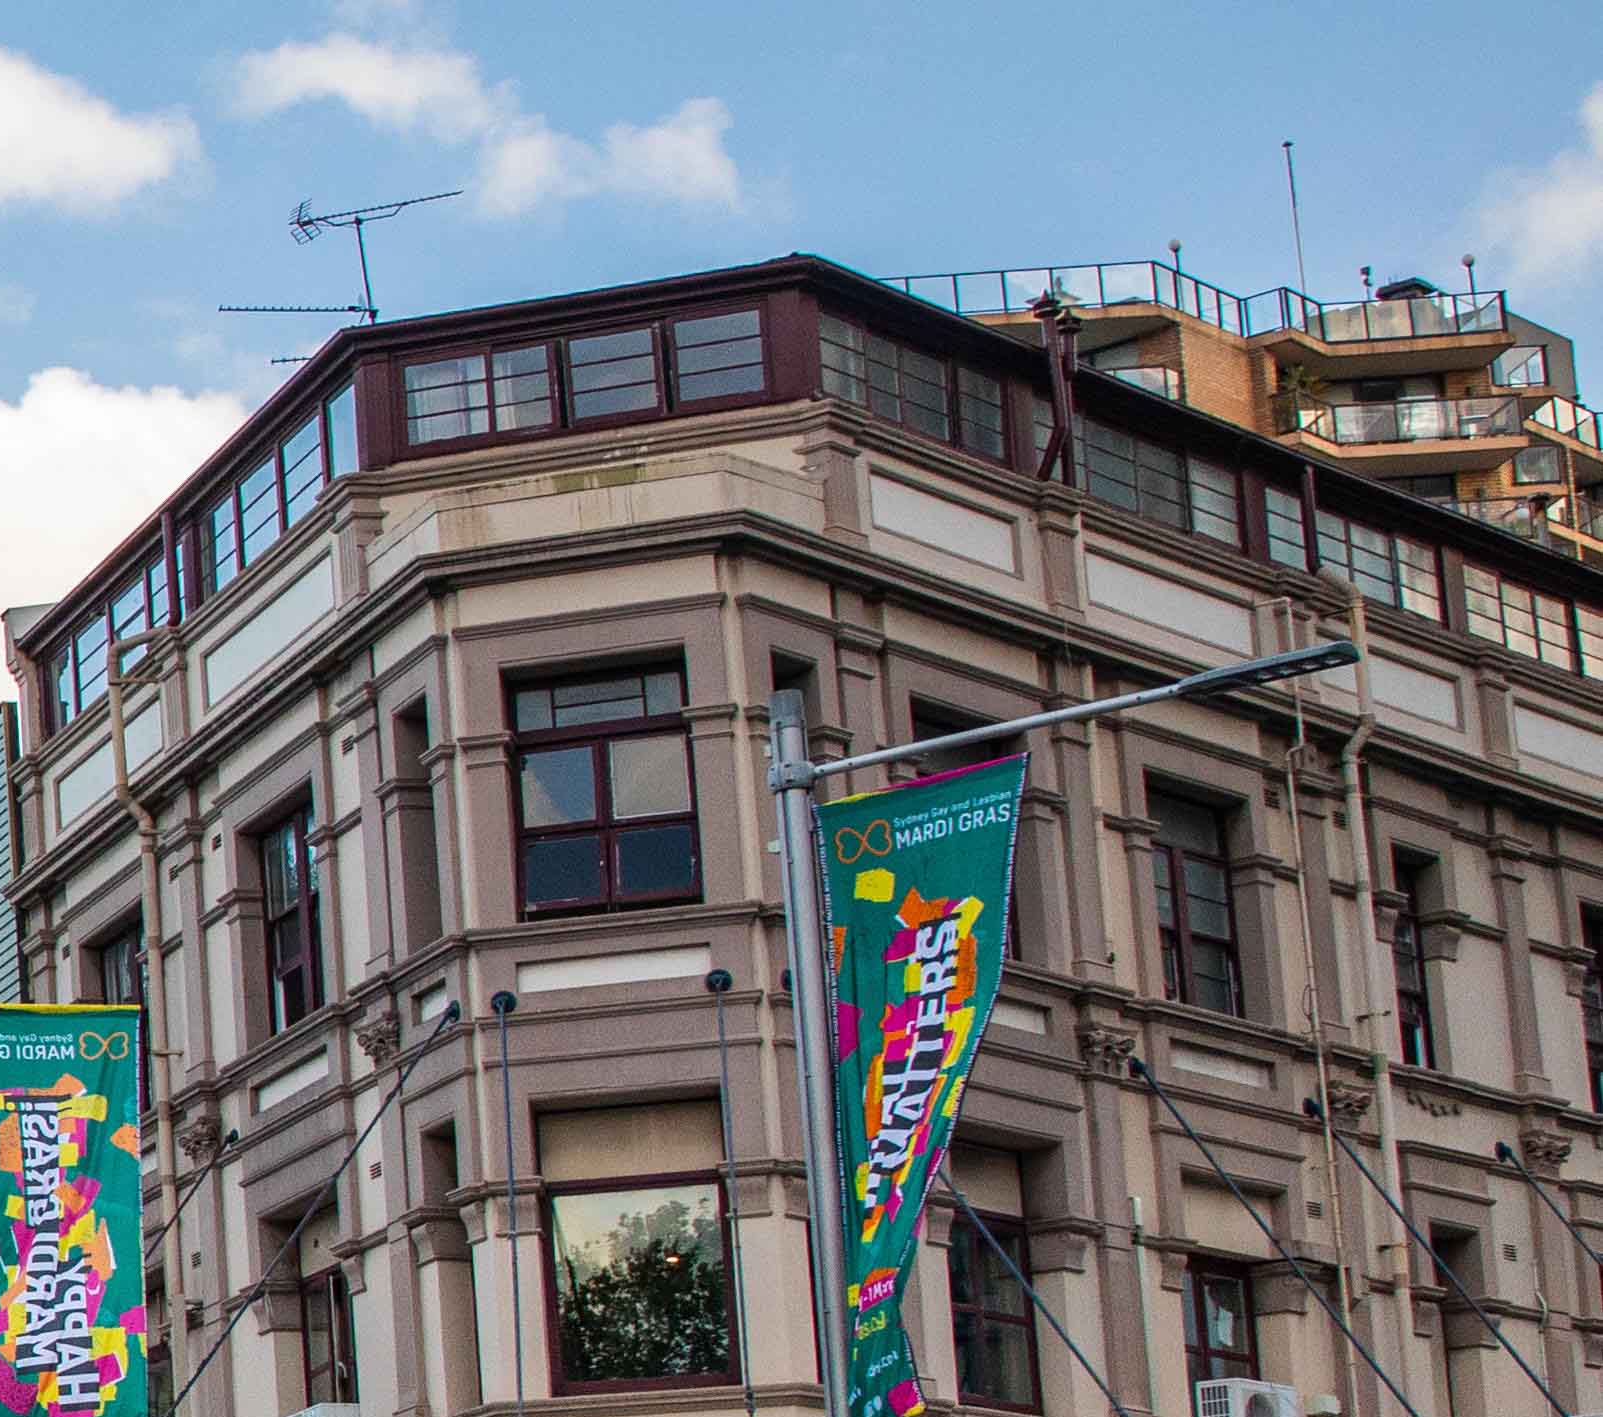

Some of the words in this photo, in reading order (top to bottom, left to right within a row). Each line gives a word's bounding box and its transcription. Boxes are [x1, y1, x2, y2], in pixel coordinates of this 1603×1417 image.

[893, 813, 929, 828] Sydney
[930, 807, 948, 818] Gay
[951, 800, 970, 811] and
[973, 791, 1012, 805] Lesbian
[894, 818, 953, 850] MARDI
[958, 803, 1011, 832] GRAS
